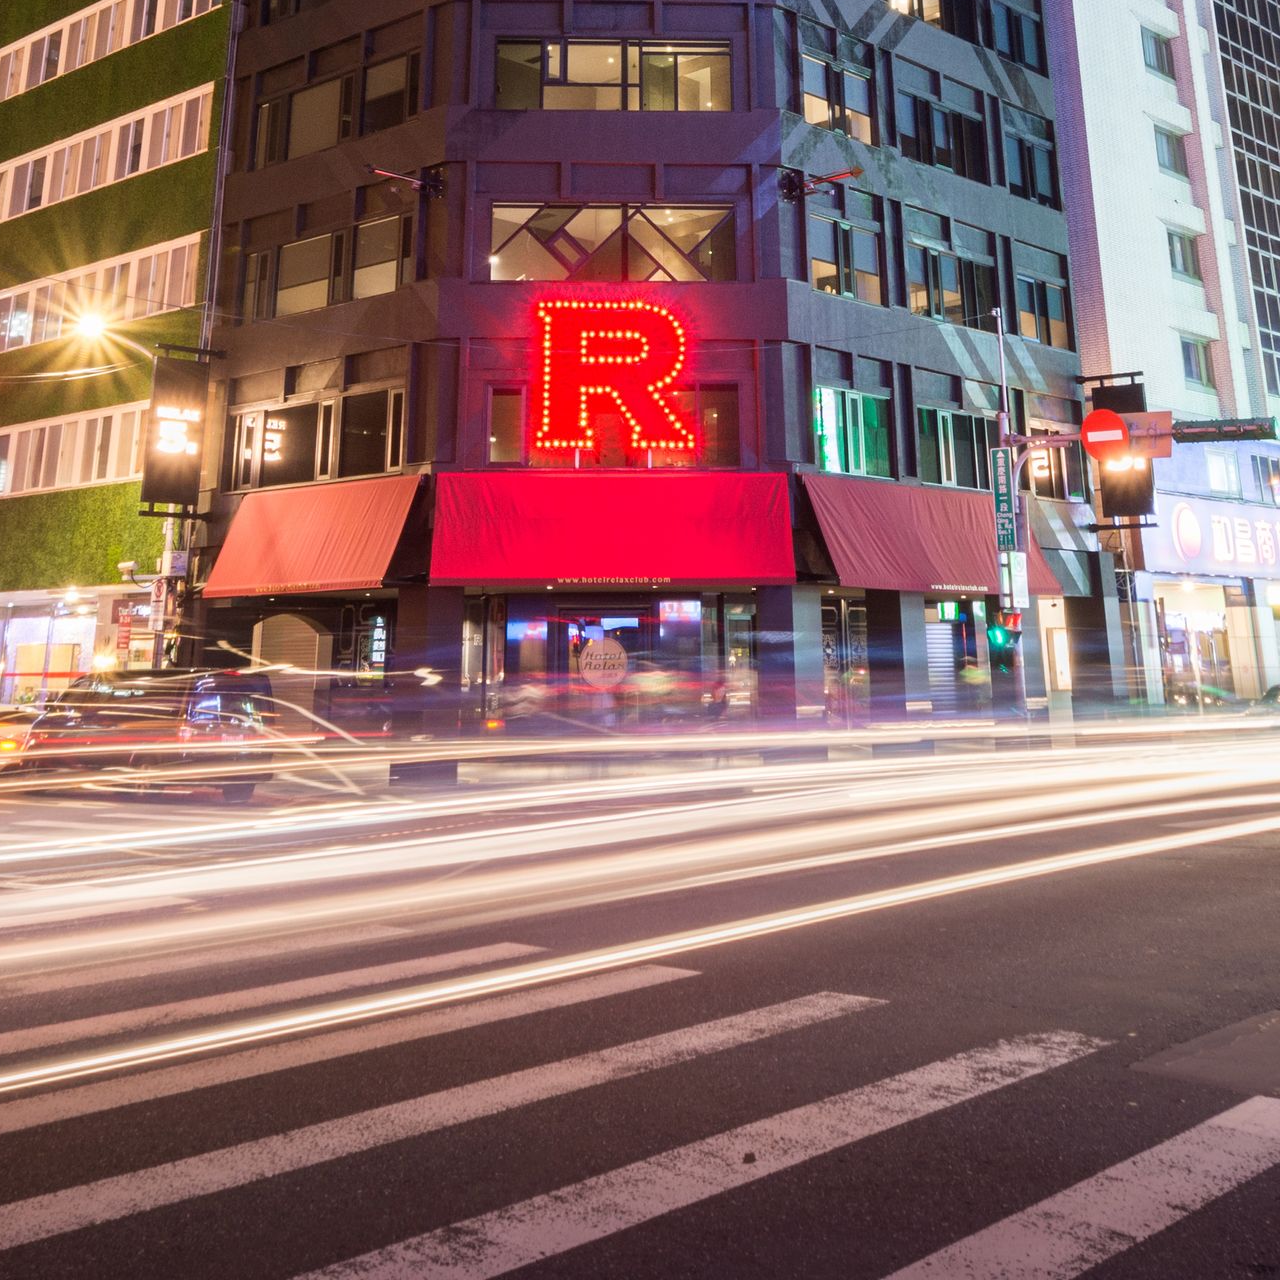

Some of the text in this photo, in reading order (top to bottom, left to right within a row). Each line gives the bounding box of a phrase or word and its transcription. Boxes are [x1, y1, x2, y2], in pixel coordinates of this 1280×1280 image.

[535, 300, 698, 448] R
[557, 576, 671, 584] www.hotelrelaxclub.com
[584, 651, 623, 660] Hotel
